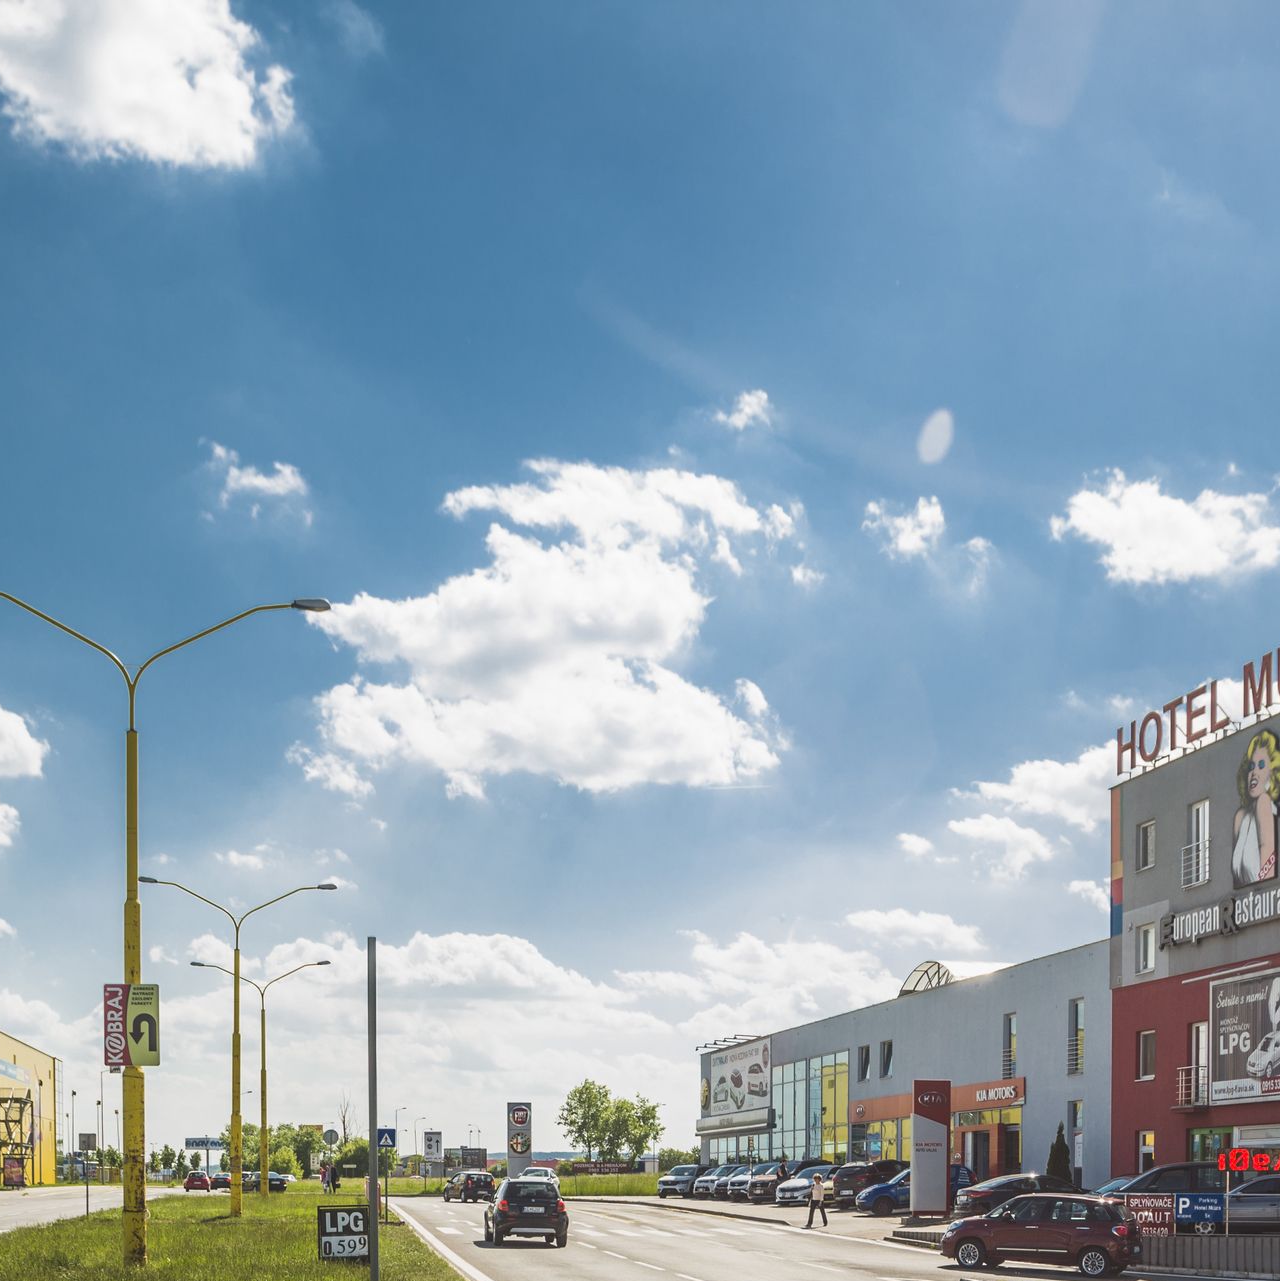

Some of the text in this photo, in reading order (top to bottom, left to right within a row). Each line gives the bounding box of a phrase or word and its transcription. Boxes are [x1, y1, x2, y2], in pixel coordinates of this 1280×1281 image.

[1116, 680, 1231, 777] HOTEL
[1260, 853, 1276, 880] SOLD
[1216, 991, 1240, 1009] Šetrite
[1246, 985, 1269, 1004] nami!
[1220, 1031, 1251, 1056] LPG
[976, 1085, 1016, 1102] KIA MOTORS
[1262, 1080, 1275, 1092] 0915
[923, 1095, 942, 1103] KIA
[1130, 1197, 1172, 1208] SPLYŇOVAČE
[1179, 1198, 1190, 1214] P
[325, 1212, 364, 1233] LPG
